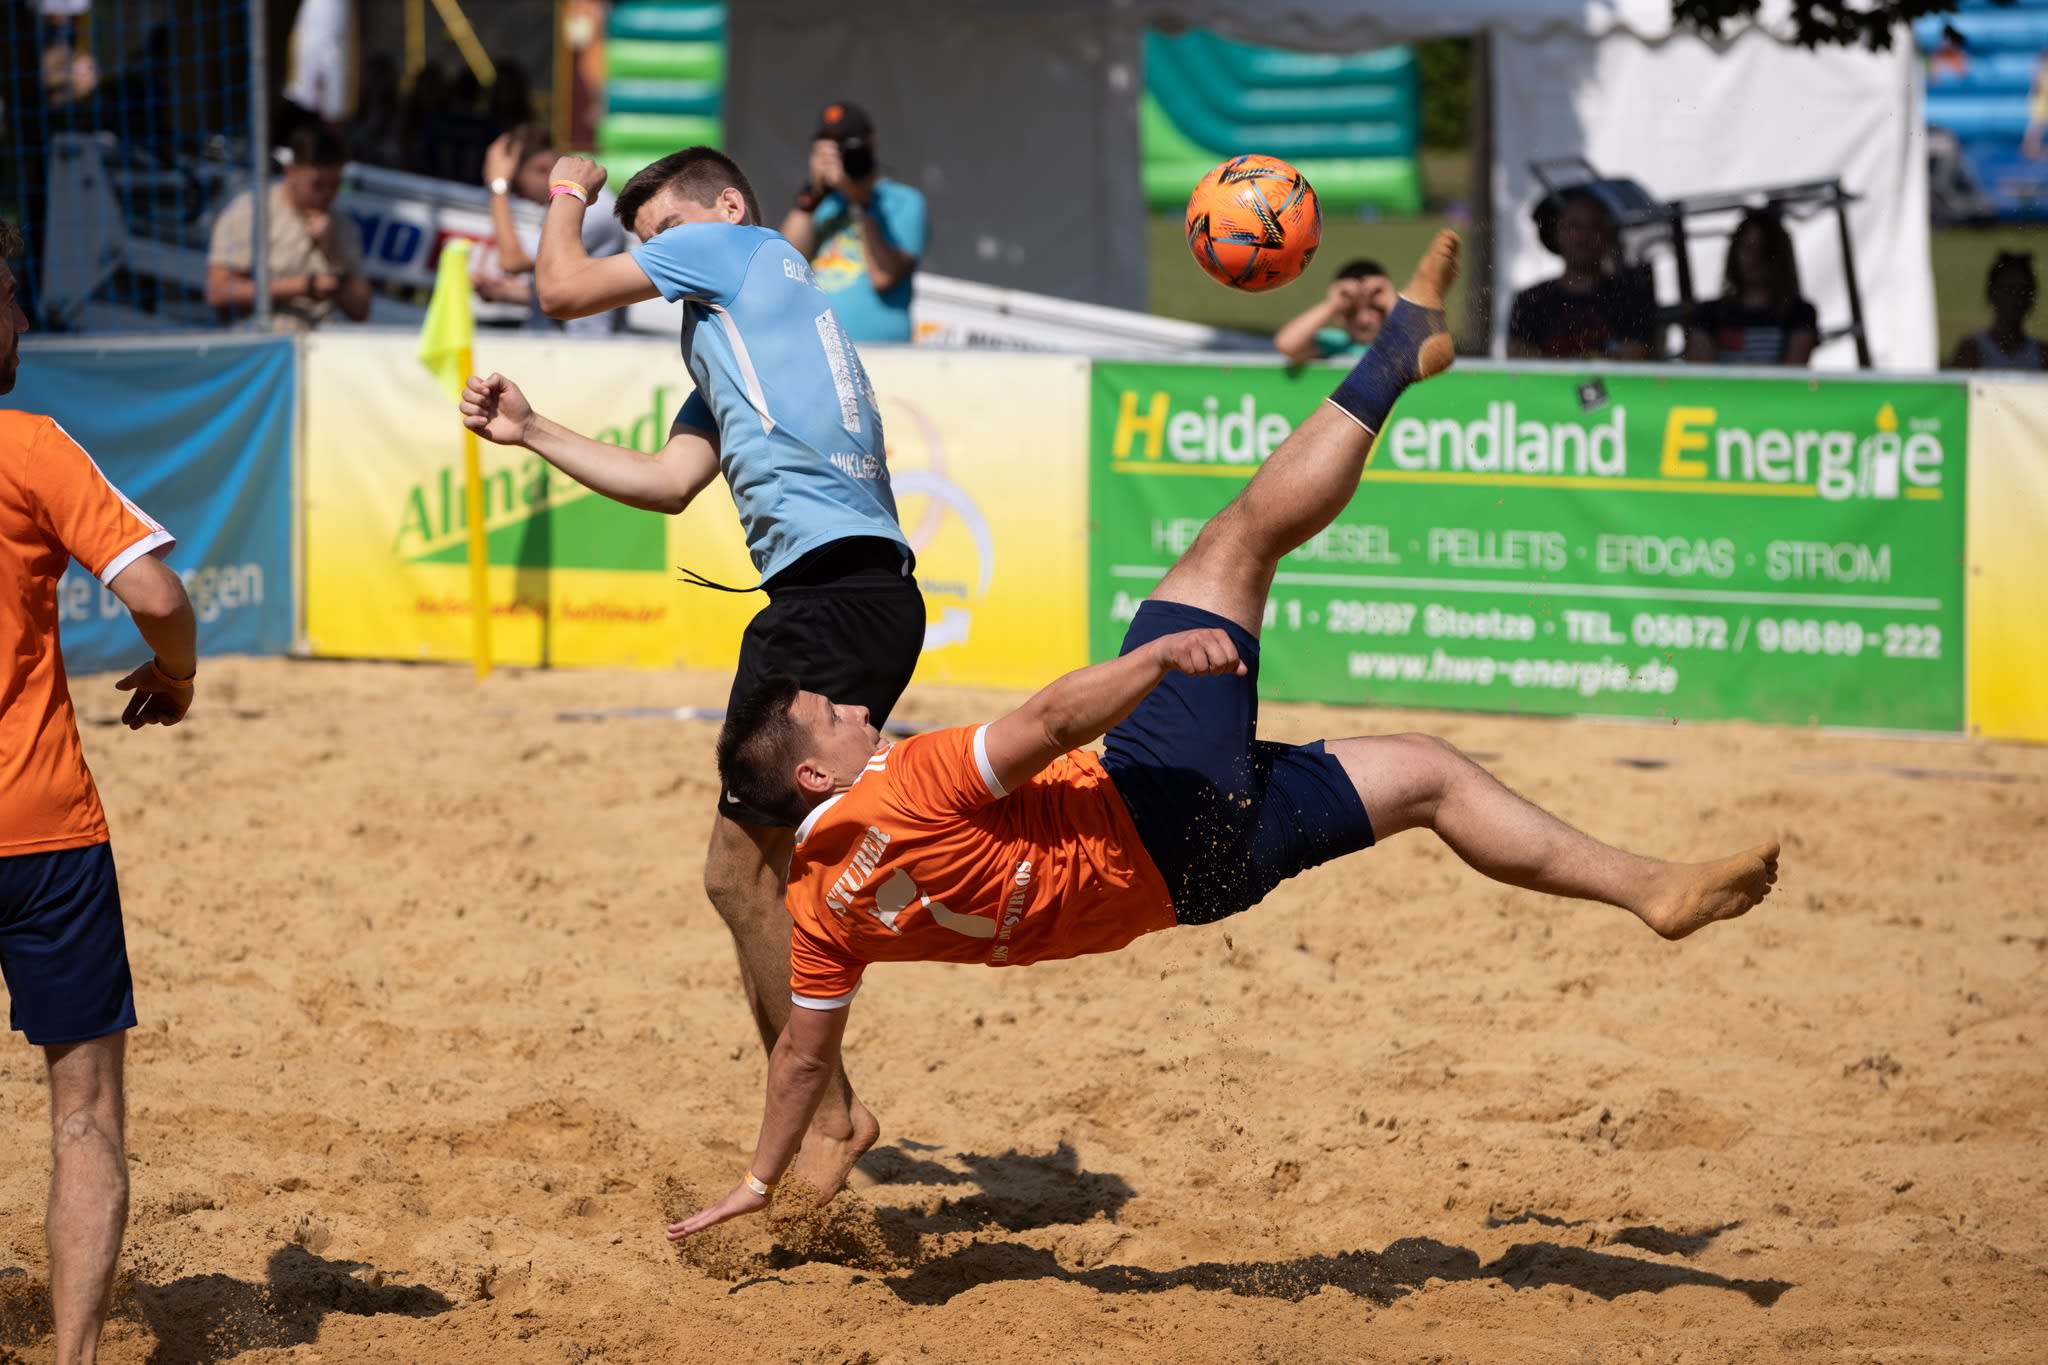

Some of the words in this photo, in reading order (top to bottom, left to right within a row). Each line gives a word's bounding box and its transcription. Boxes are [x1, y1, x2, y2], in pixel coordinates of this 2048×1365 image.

[1113, 391, 1291, 463] Heide
[1362, 400, 1627, 476] endland
[1429, 527, 1568, 570] PELLETS
[1597, 534, 1735, 577] ERDGAS
[1765, 541, 1891, 582] STROM
[1424, 604, 1536, 642] Stoetze
[1348, 648, 1679, 697] www.hwe-energie.de
[825, 825, 891, 918] STUBER
